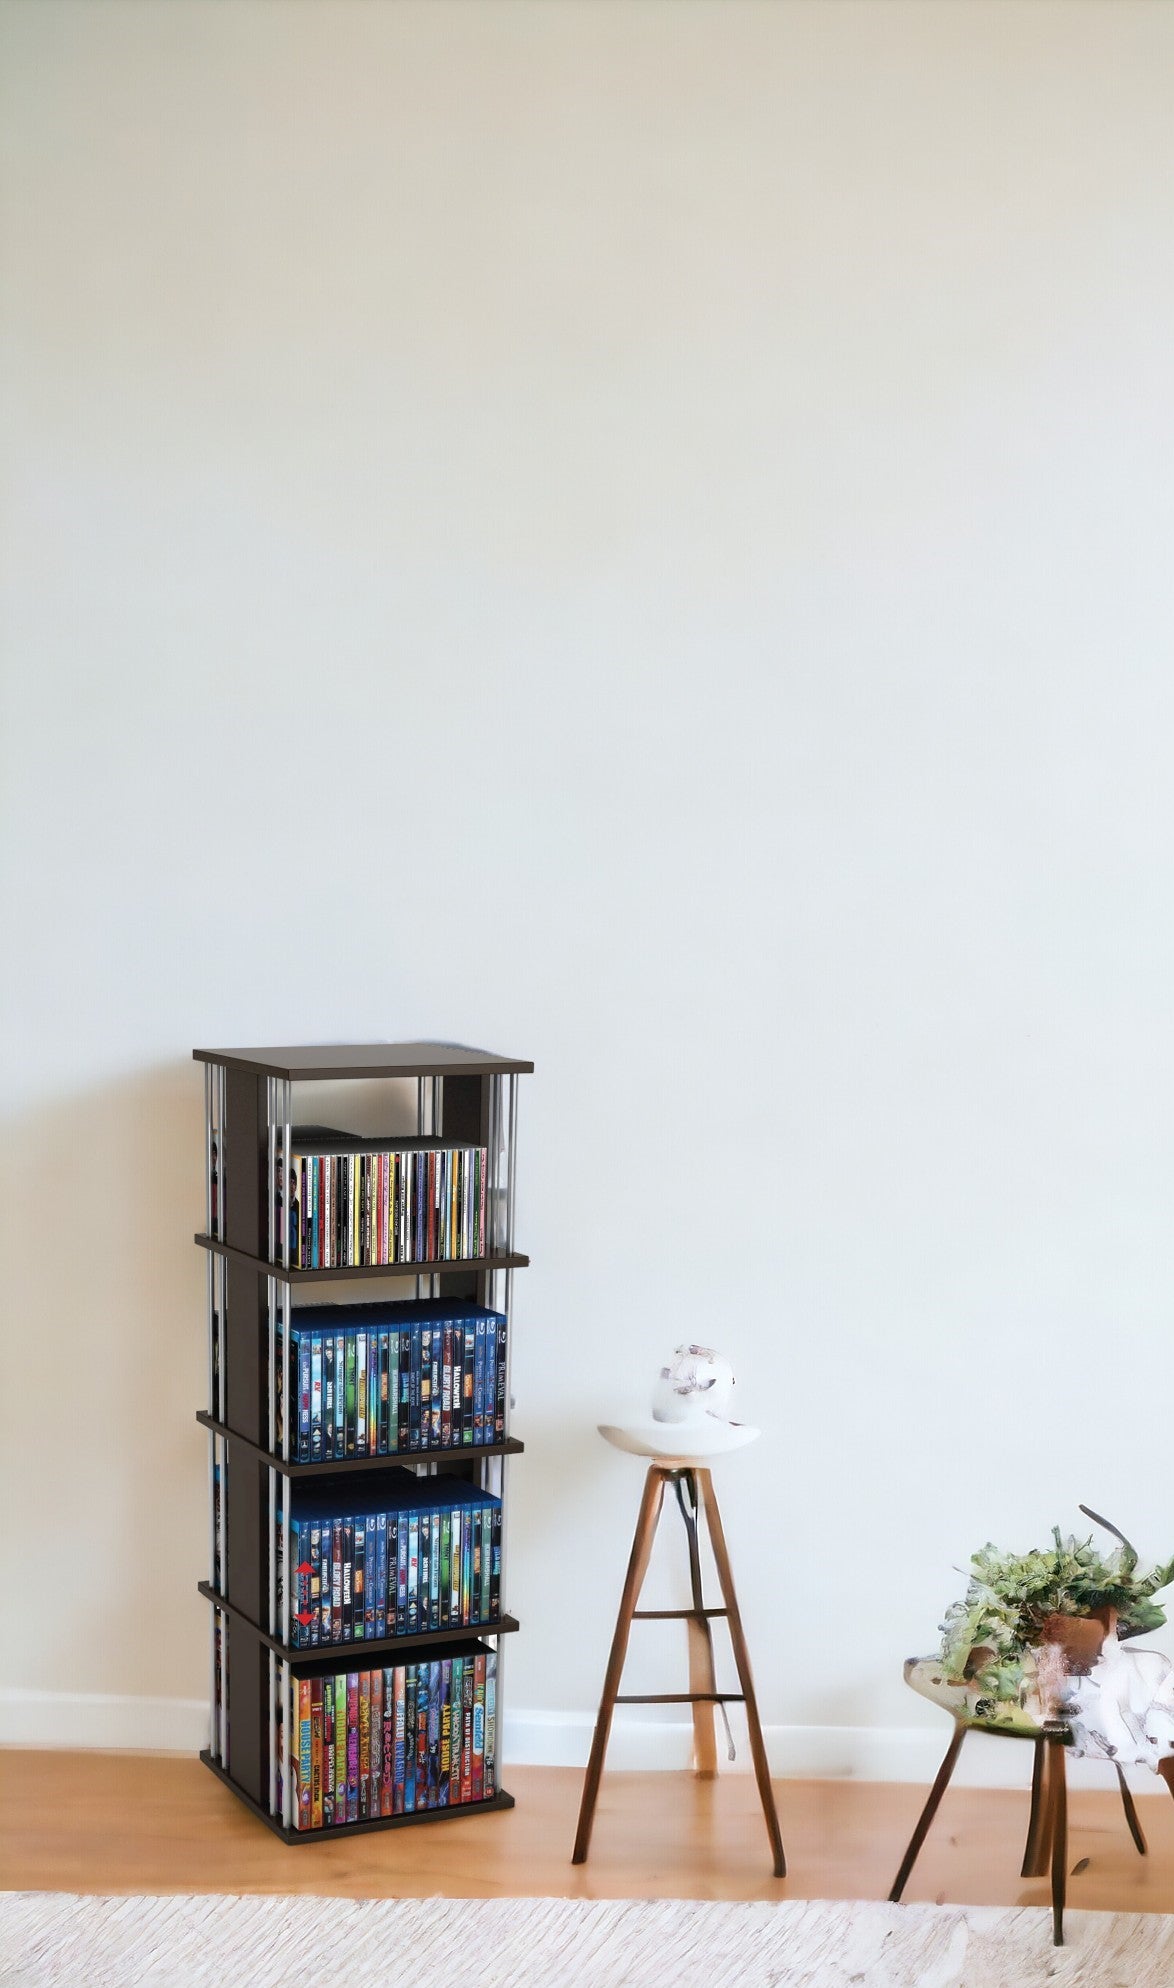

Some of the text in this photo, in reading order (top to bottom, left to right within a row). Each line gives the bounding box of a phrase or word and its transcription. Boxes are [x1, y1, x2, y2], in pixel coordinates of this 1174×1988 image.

[315, 1381, 321, 1392] RV
[443, 1365, 451, 1411] GLORY ROAD
[453, 1366, 461, 1408] HALLOWEEN
[343, 1562, 351, 1604] HALLOWEEN
[411, 1557, 417, 1567] RV
[333, 1562, 341, 1608] GLORY ROAD
[441, 1704, 451, 1772] HOUSE PARTY
[464, 1712, 472, 1728] PATH
[464, 1728, 472, 1736] OF
[475, 1707, 485, 1749] Seinfeld
[299, 1720, 311, 1784] HOUSE PARTY
[336, 1713, 346, 1781] HOUSE PARTY
[348, 1733, 359, 1779] REMEMBER
[395, 1700, 405, 1784] BUFFALO INVASION
[464, 1736, 472, 1776] DESTRUCTION
[313, 1764, 321, 1786] CACTUS
